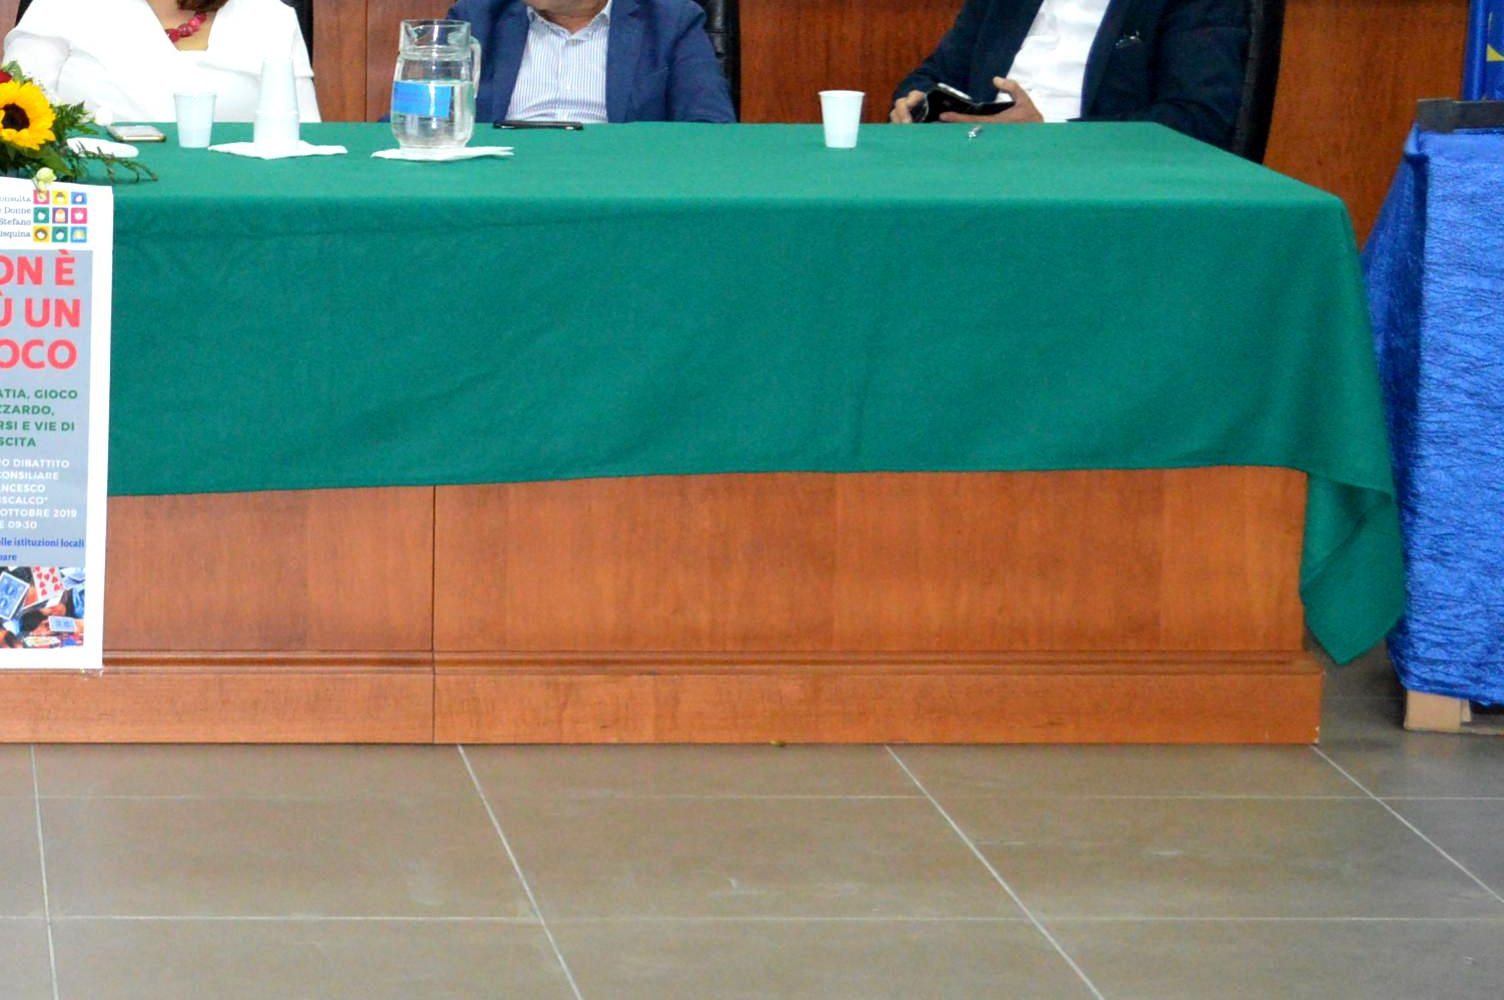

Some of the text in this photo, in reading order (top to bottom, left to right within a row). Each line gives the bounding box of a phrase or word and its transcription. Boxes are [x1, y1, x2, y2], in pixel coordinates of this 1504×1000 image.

[4, 207, 31, 215] Donne
[54, 248, 76, 286] È
[24, 298, 81, 328] UN
[34, 389, 78, 400] GIOCO
[22, 421, 30, 431] E
[34, 421, 57, 431] VIE
[61, 422, 75, 432] DI
[13, 458, 70, 469] DIBATTITO
[0, 508, 50, 518] OTTOBRE
[13, 538, 60, 548] istituzioni
[60, 538, 85, 548] locali
